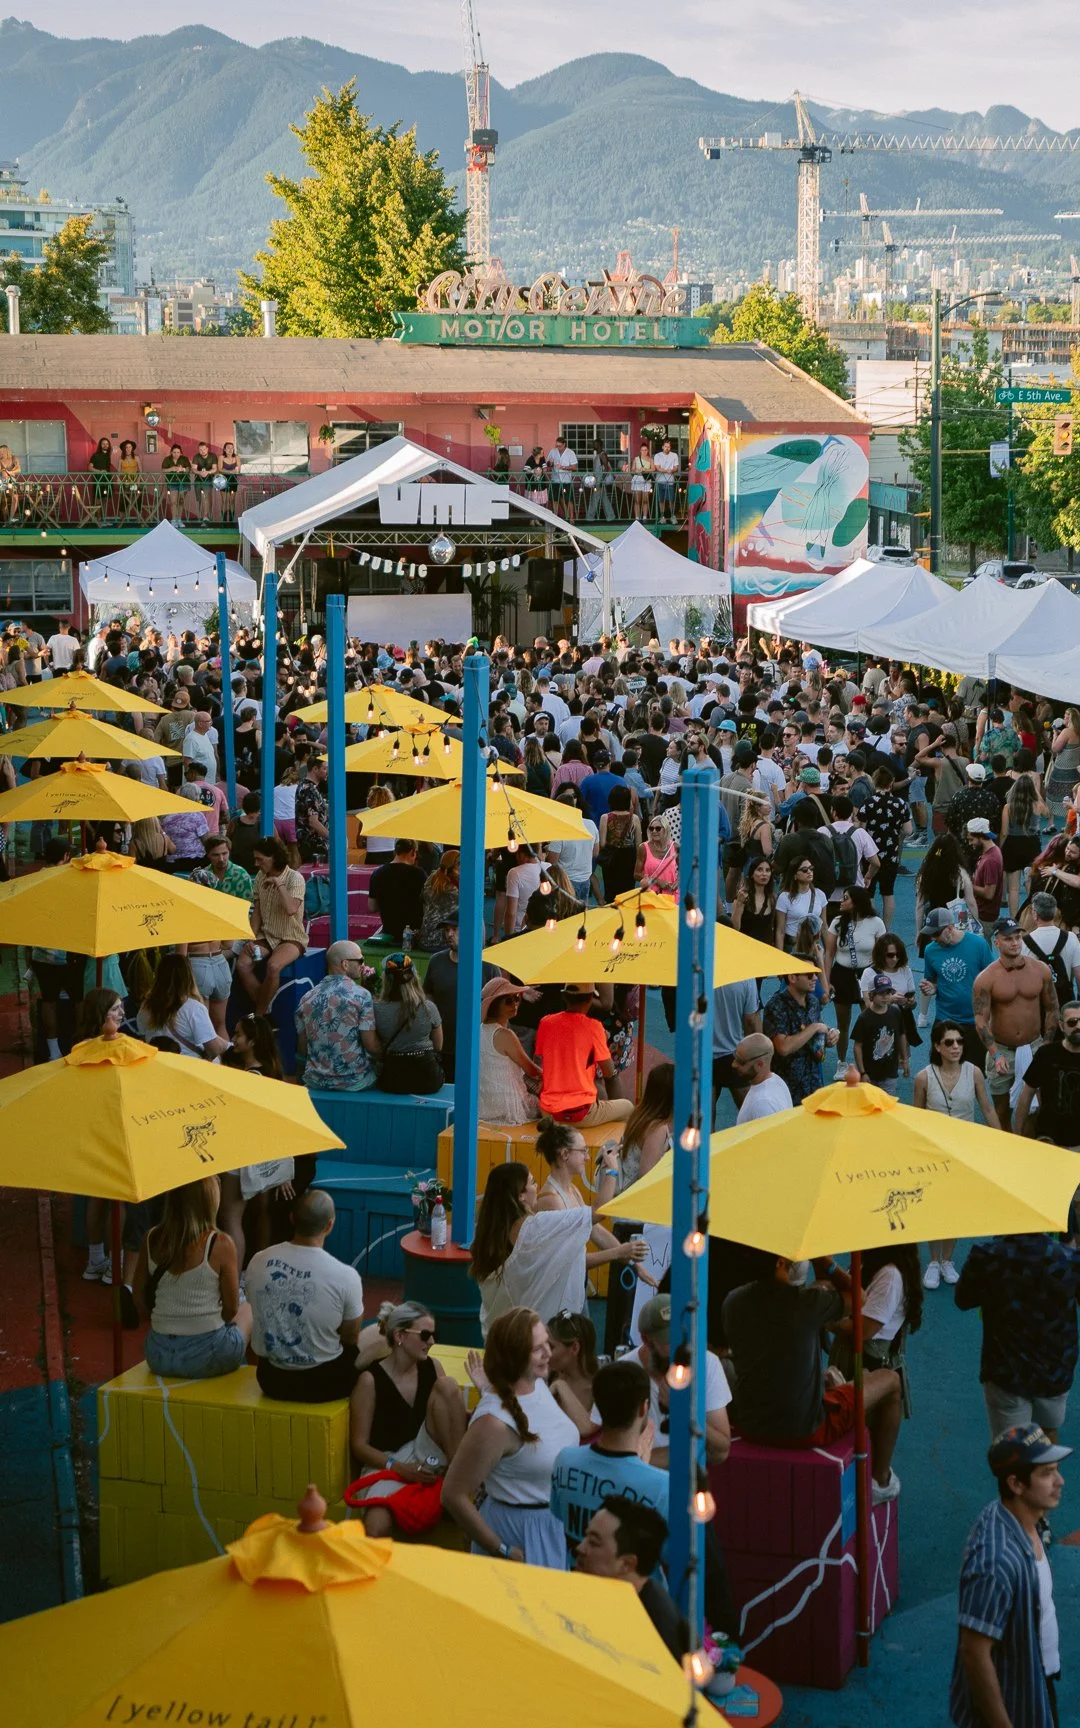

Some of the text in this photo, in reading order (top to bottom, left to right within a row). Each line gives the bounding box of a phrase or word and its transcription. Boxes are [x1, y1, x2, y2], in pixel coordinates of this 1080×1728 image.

[441, 319, 666, 341] MOTOR HOTEL
[1018, 391, 1064, 401] E 5th Ave.
[358, 552, 521, 578] PUBLIC DISCO
[267, 1260, 311, 1279] BETTER
